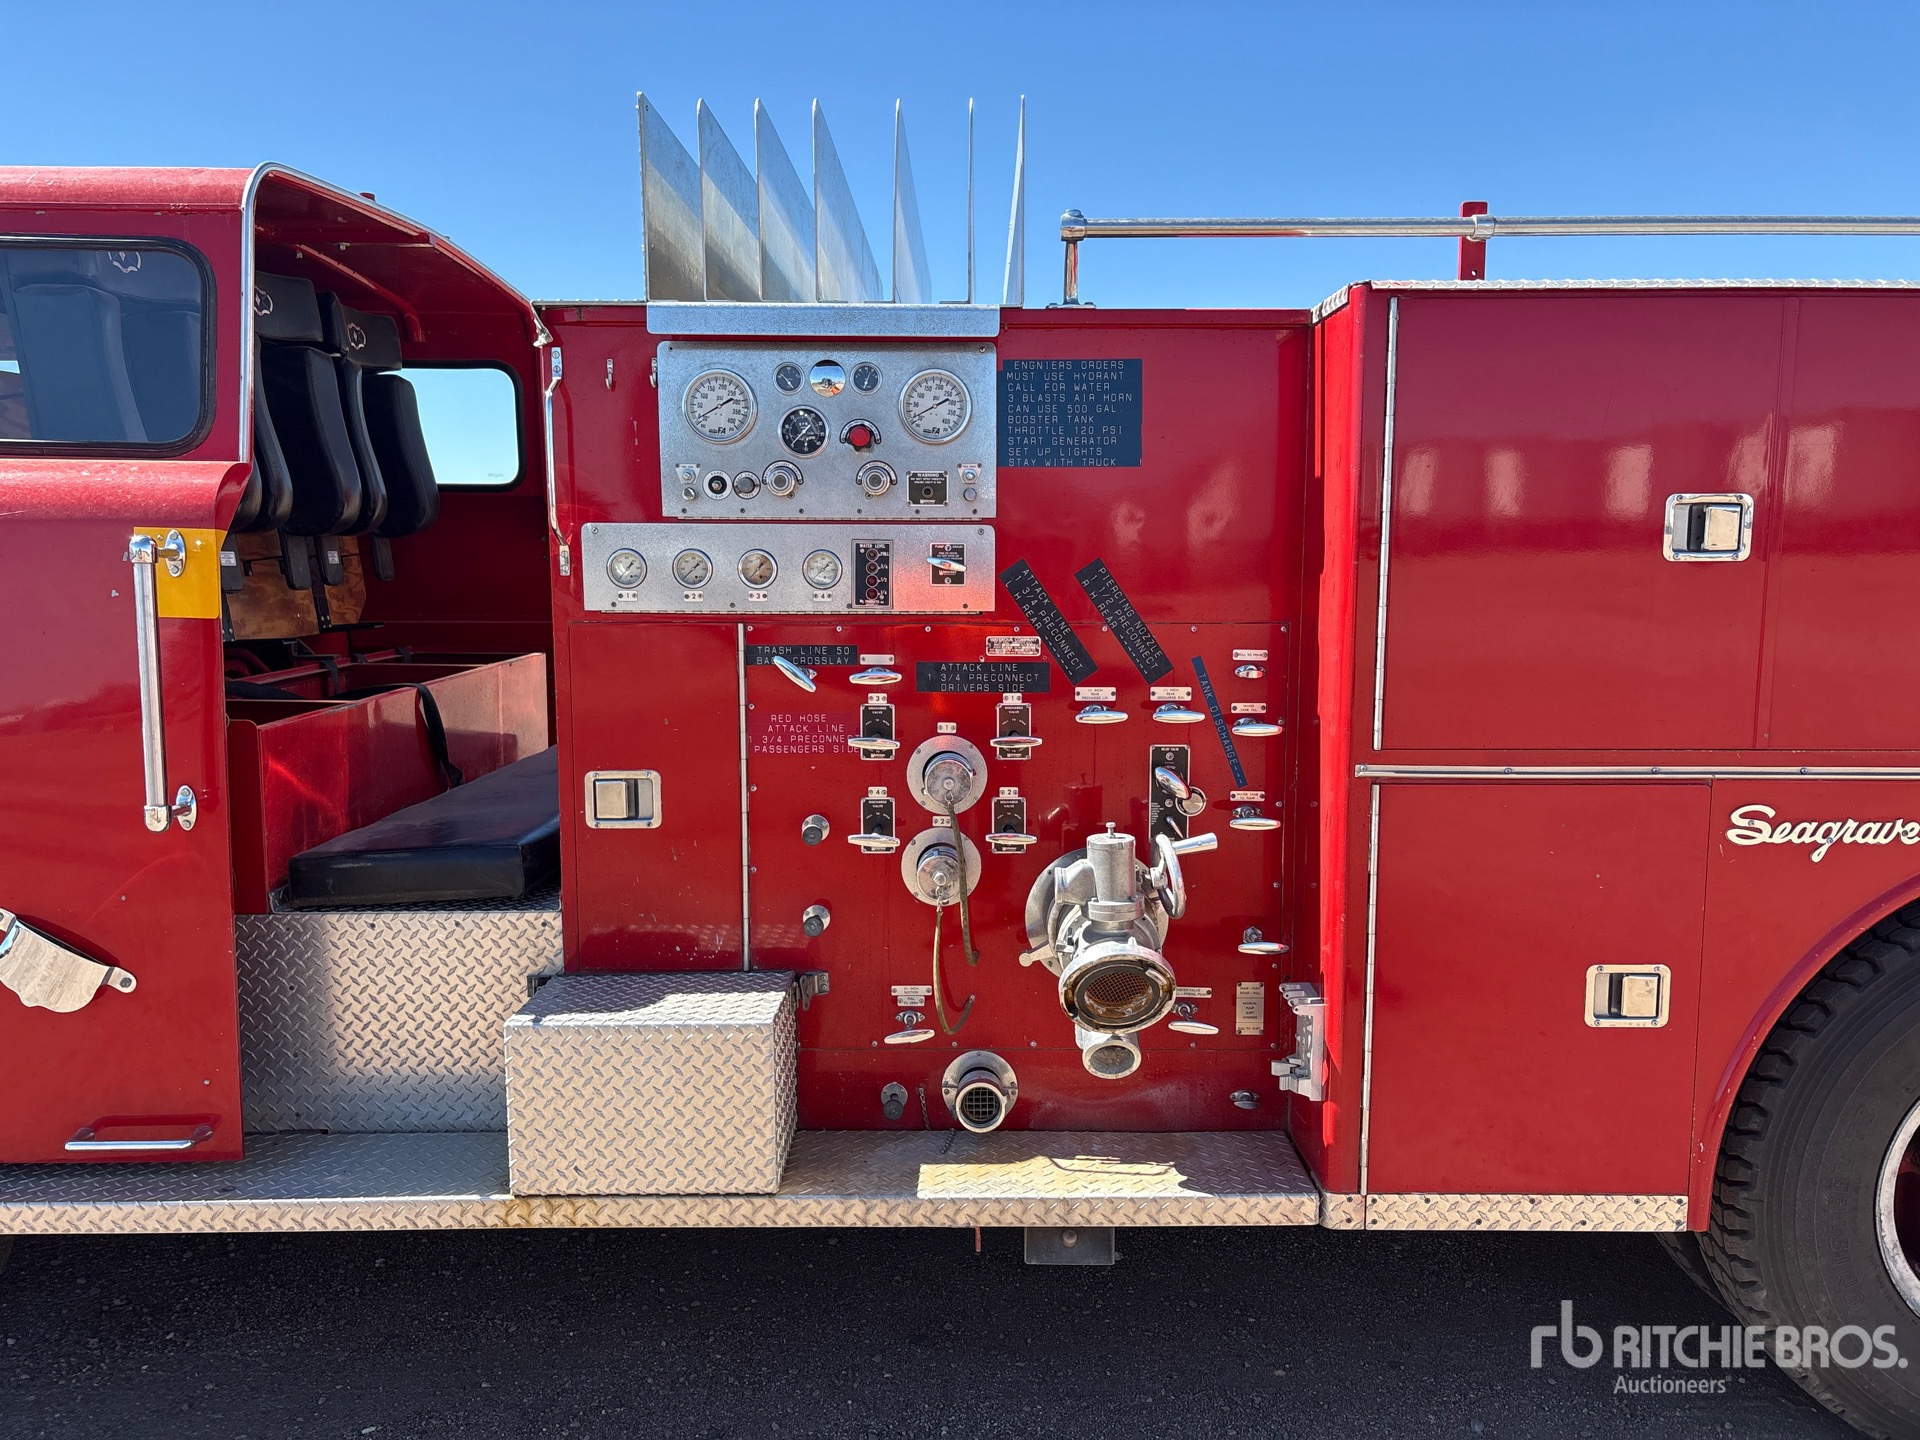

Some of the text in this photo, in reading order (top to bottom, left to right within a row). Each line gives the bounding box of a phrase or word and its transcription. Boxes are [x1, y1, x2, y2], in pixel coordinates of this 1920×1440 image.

[1014, 360, 1124, 370] ENGNIERS ORDERS
[1006, 372, 1124, 381] MUST USE HYDRANT
[1008, 382, 1110, 392] CALL FOR WATER
[1008, 394, 1133, 403] 3 BLASTS AIR HORN
[1008, 404, 1123, 414] CAN USE 500 GAL.
[1008, 416, 1095, 424] BOOSTER TANK
[1008, 426, 1123, 435] THROTTLE 120 PSI
[1008, 437, 1117, 446] START GENERATOR
[1008, 448, 1103, 456] SET UP LIGHTS
[1008, 458, 1116, 467] STAY WITH TRUCK
[1005, 580, 1043, 630] L H REAR
[1022, 569, 1072, 635] ATTACK LINE
[1081, 580, 1118, 629] R H REAR
[1098, 567, 1163, 659] PIERCING NOZZLE
[1022, 587, 1038, 606] 3/4
[1038, 610, 1084, 671] PRECONNECT
[1099, 586, 1114, 604] 1/2
[1114, 610, 1159, 670] PRECONNECT
[757, 647, 792, 655] TRASH
[800, 647, 827, 655] LINE
[756, 657, 850, 665] BA CROSSLAY
[941, 664, 1018, 672] ATTACK LINE
[928, 674, 1040, 682] 1 3/4 PRECONNECT
[941, 684, 1025, 692] DRIVERS SIDE
[771, 714, 827, 723] RED HOSE
[1198, 672, 1238, 765] TANK DISCHARGE
[768, 725, 844, 733] ATTACK LINE
[762, 735, 782, 743] 3/4
[755, 746, 825, 754] PASSENGERS
[1726, 804, 1920, 863] Seagrave
